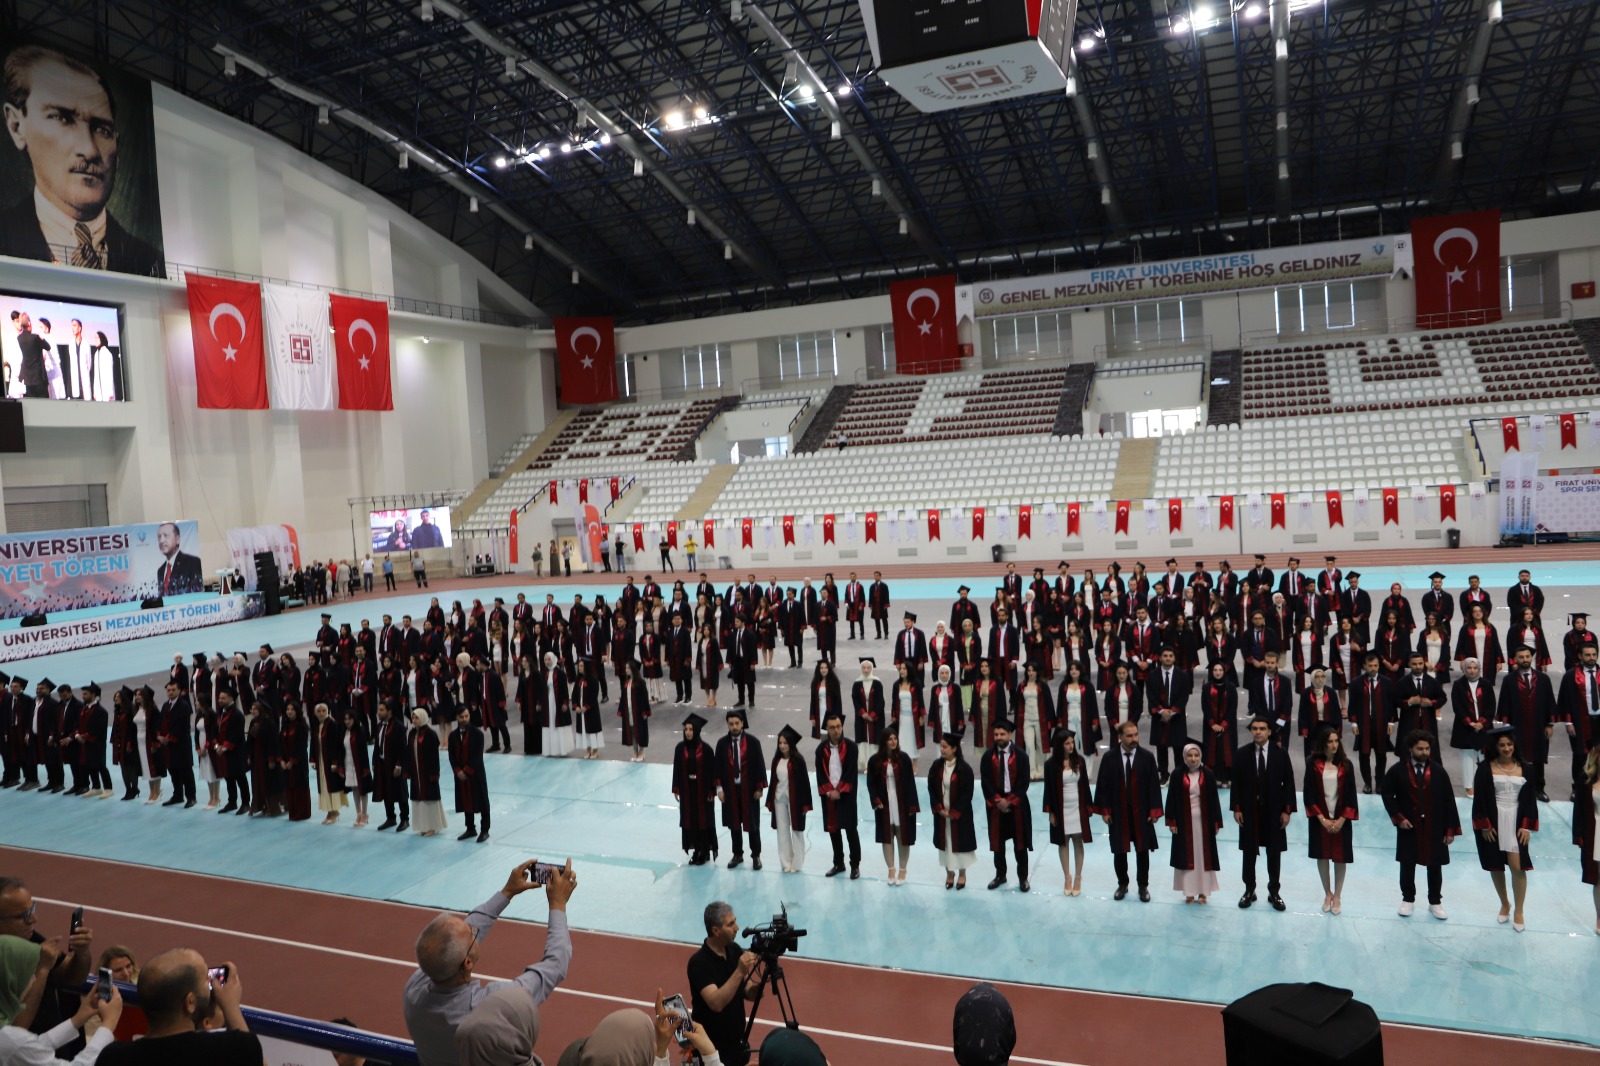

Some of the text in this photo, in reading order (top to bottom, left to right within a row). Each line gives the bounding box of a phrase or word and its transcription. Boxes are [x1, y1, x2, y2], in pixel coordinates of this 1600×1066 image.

[1000, 288, 1051, 305] GENEL
[1054, 277, 1145, 299] MEZUNİYET
[1238, 263, 1275, 279] HOŞ
[1279, 253, 1362, 273] GELDİNİZ
[1090, 267, 1136, 283] FIRAT
[50, 554, 130, 578] TÖRENİ
[105, 609, 176, 631] MEZUNİYET
[180, 602, 221, 618] TÖRENİ
